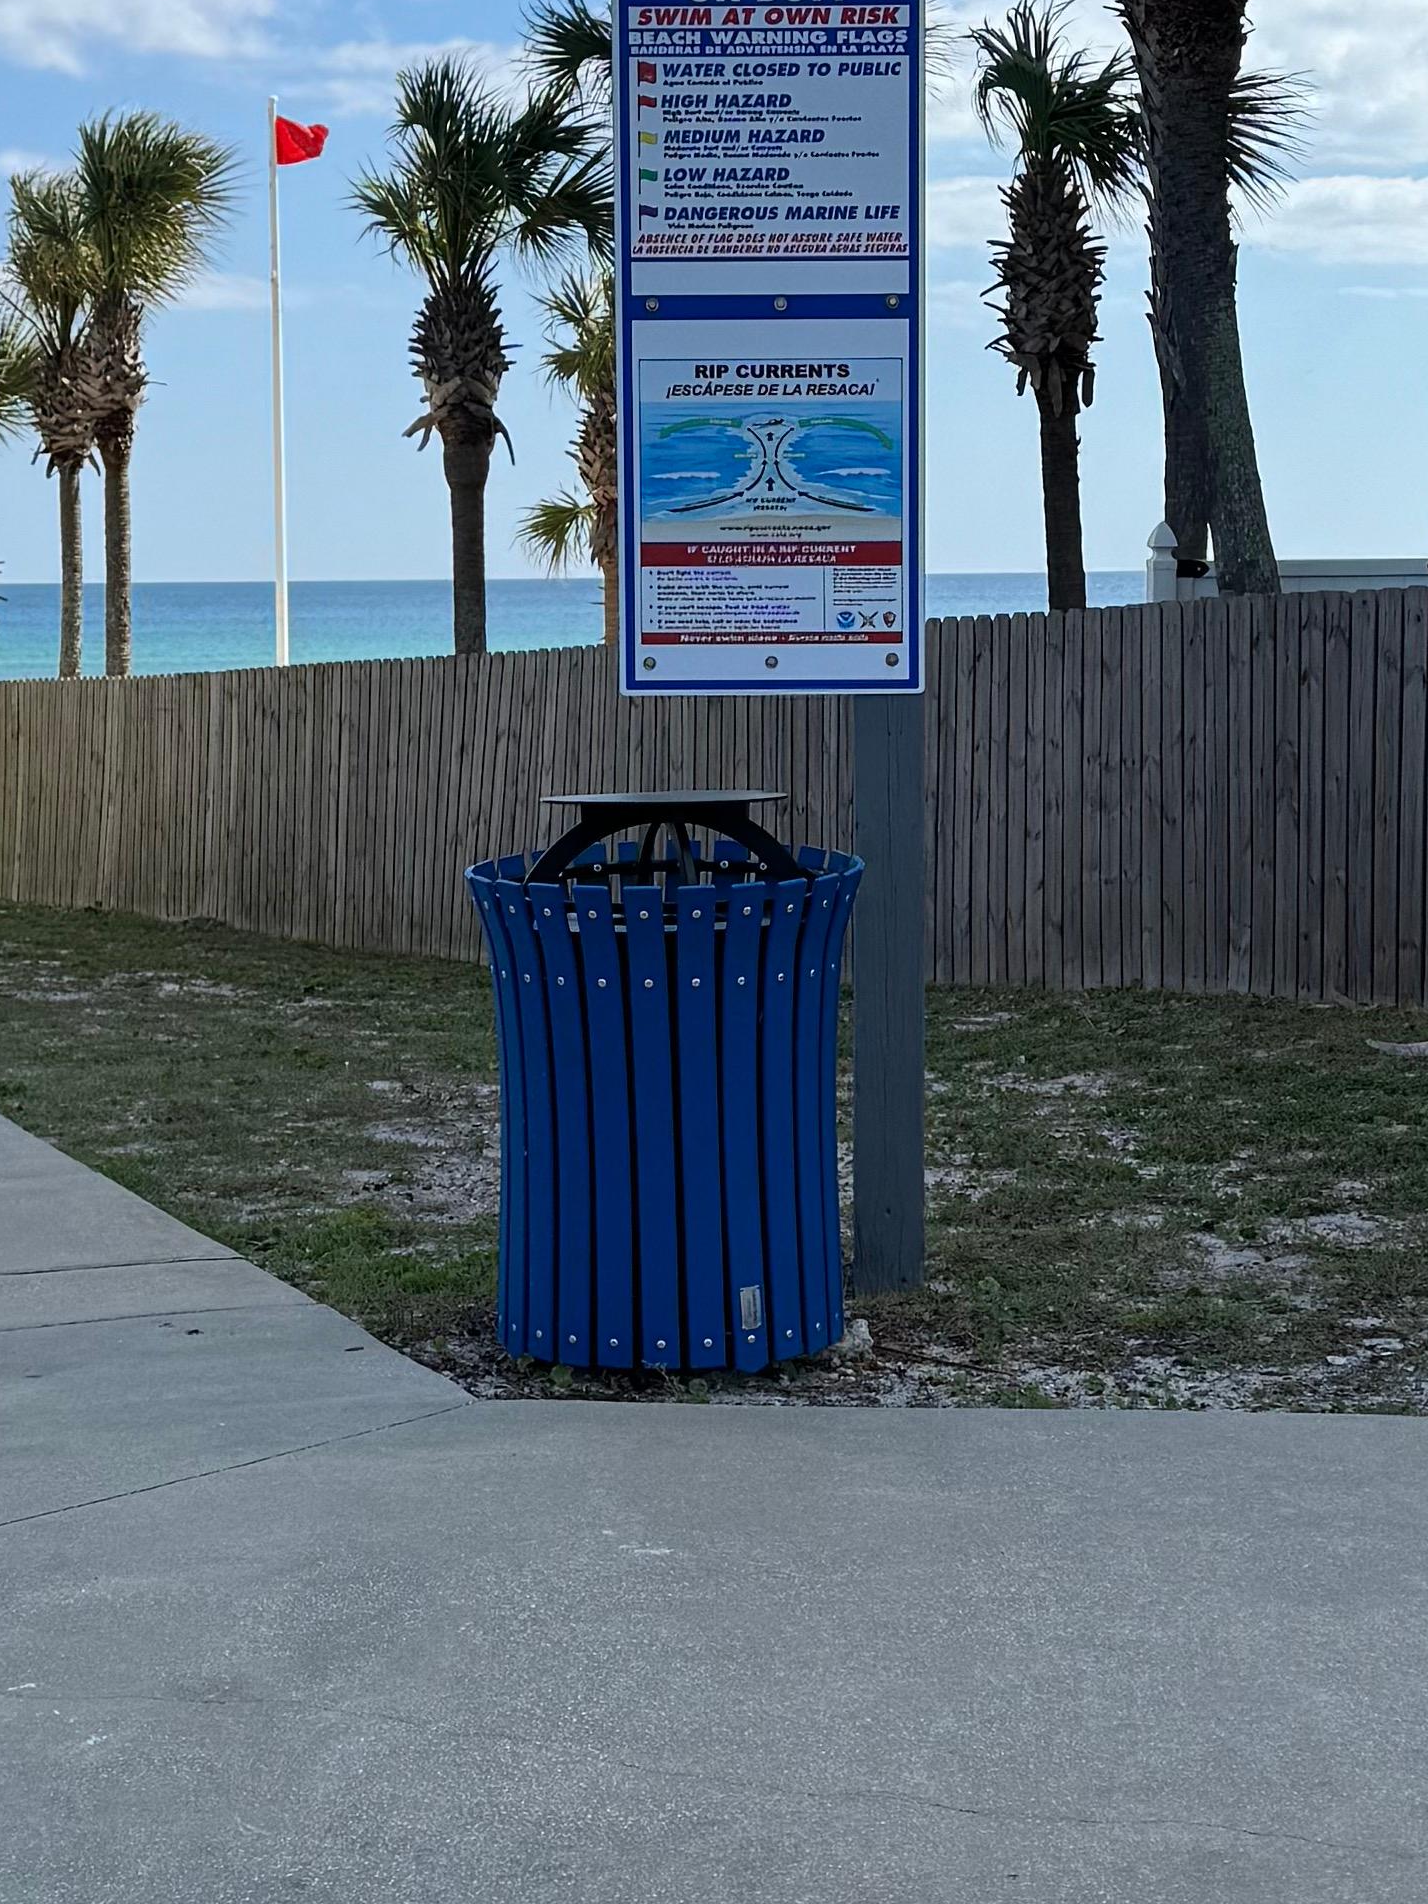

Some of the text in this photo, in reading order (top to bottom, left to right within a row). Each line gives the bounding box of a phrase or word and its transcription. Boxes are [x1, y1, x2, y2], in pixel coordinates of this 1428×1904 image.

[638, 7, 900, 26] SWIM AT OWN RISK
[628, 31, 907, 45] BEACH WARNING FLAGS
[662, 62, 901, 77] WATER CLOSED TO PUBLIC
[662, 94, 792, 108] HIGH HAZARD
[664, 129, 825, 143] MEDIUM HAZARD
[664, 167, 790, 182] LOW HAZARD
[664, 205, 900, 220] DANGEROUS MARINE LIFE
[695, 364, 849, 379] RIP CURRENTS
[758, 384, 779, 396] DE
[783, 384, 802, 396] LA
